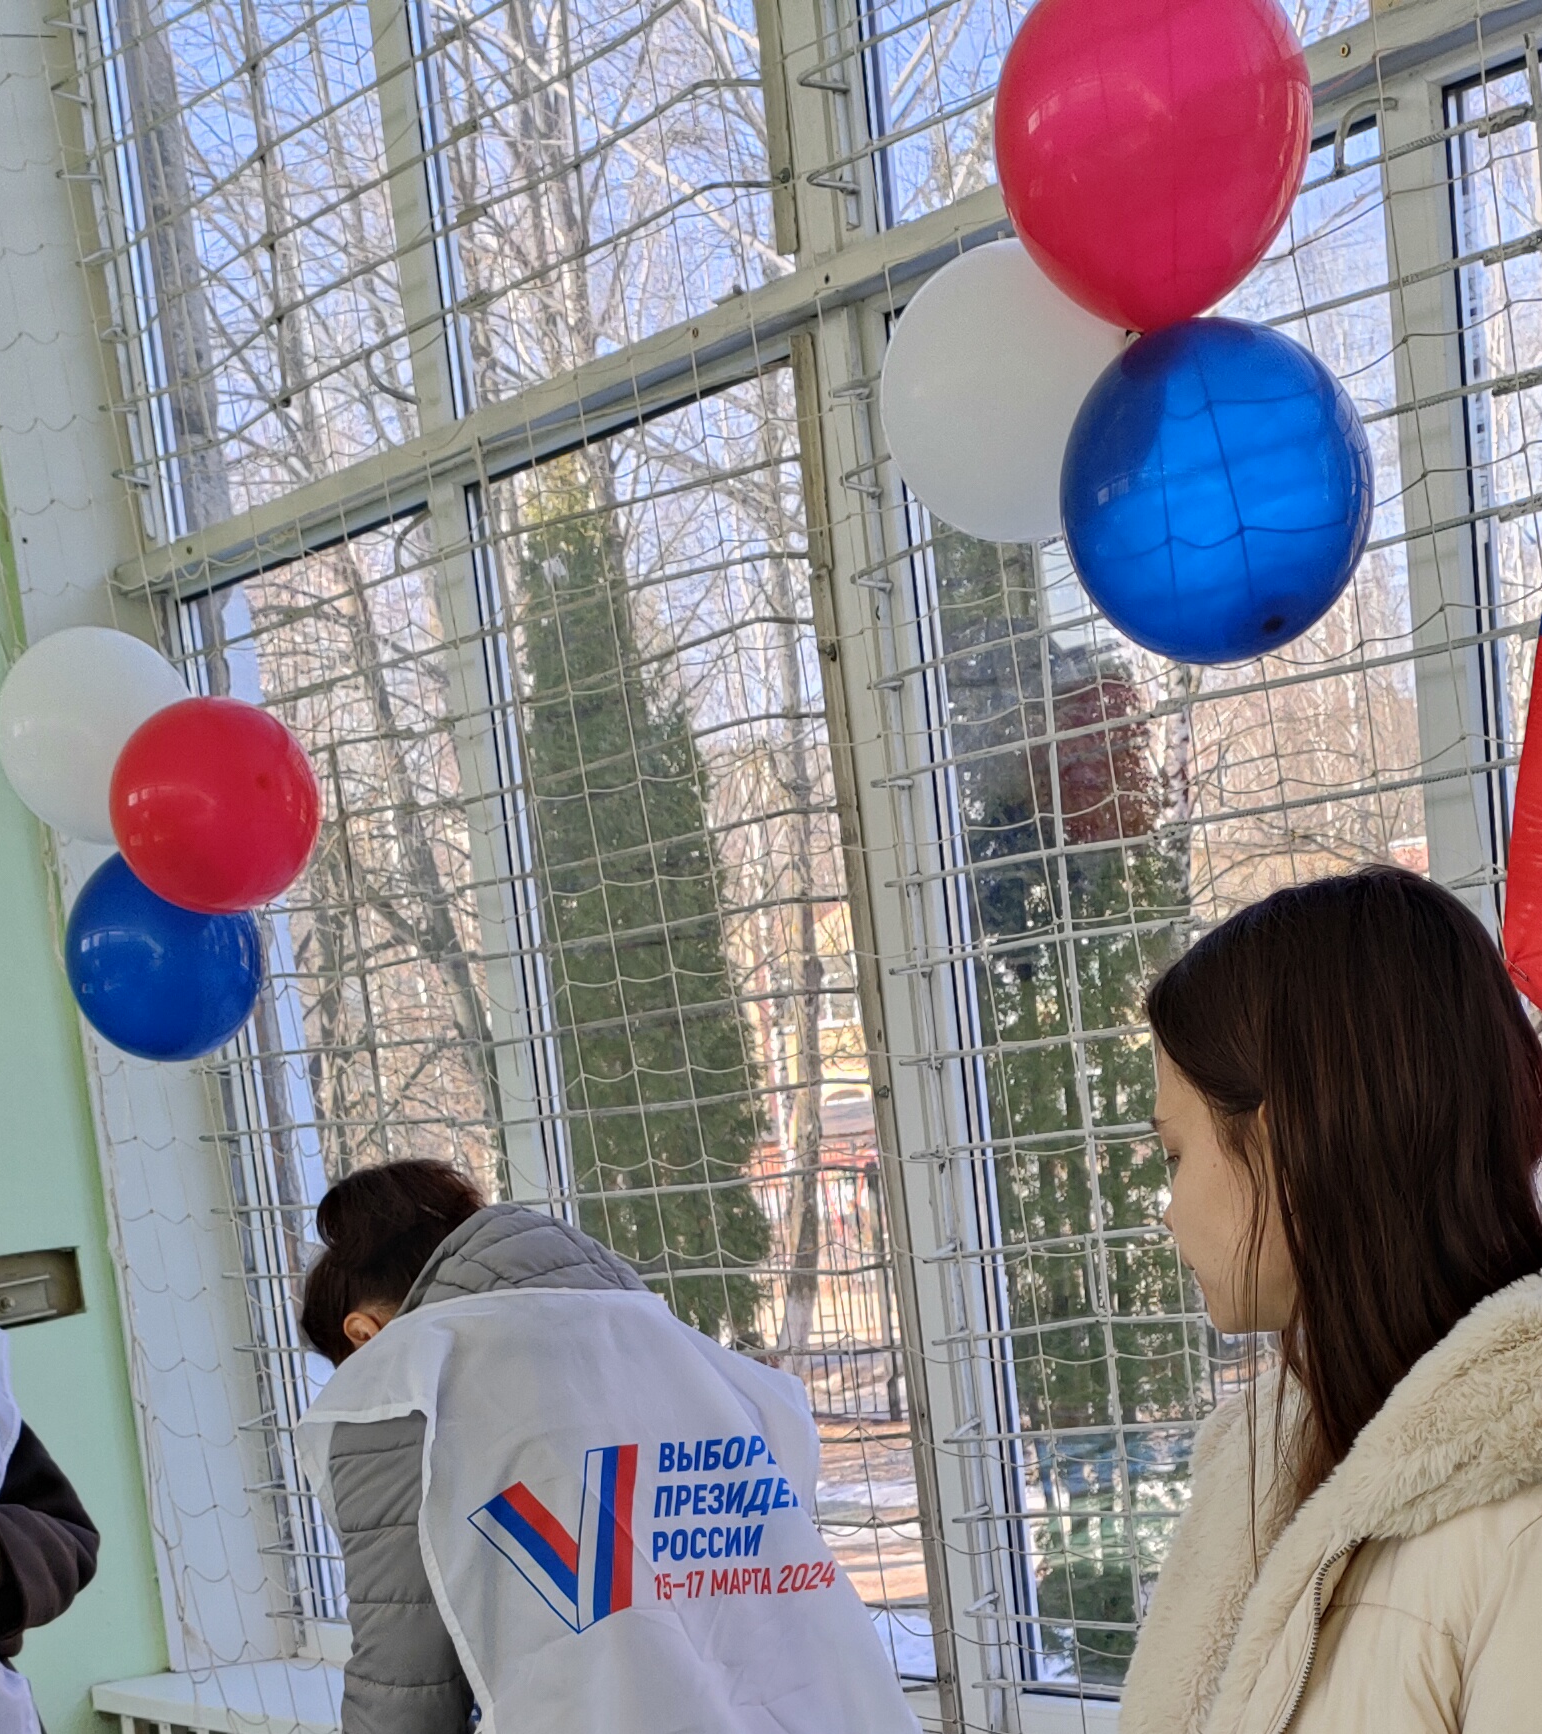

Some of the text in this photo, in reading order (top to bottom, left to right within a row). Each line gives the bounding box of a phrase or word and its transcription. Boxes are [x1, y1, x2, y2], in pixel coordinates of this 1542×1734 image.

[653, 1477, 799, 1518] ПРЕЗИДЕ
[652, 1524, 764, 1562] РОССИИ
[654, 1560, 836, 1600] 15–17 МАРТА 2024
